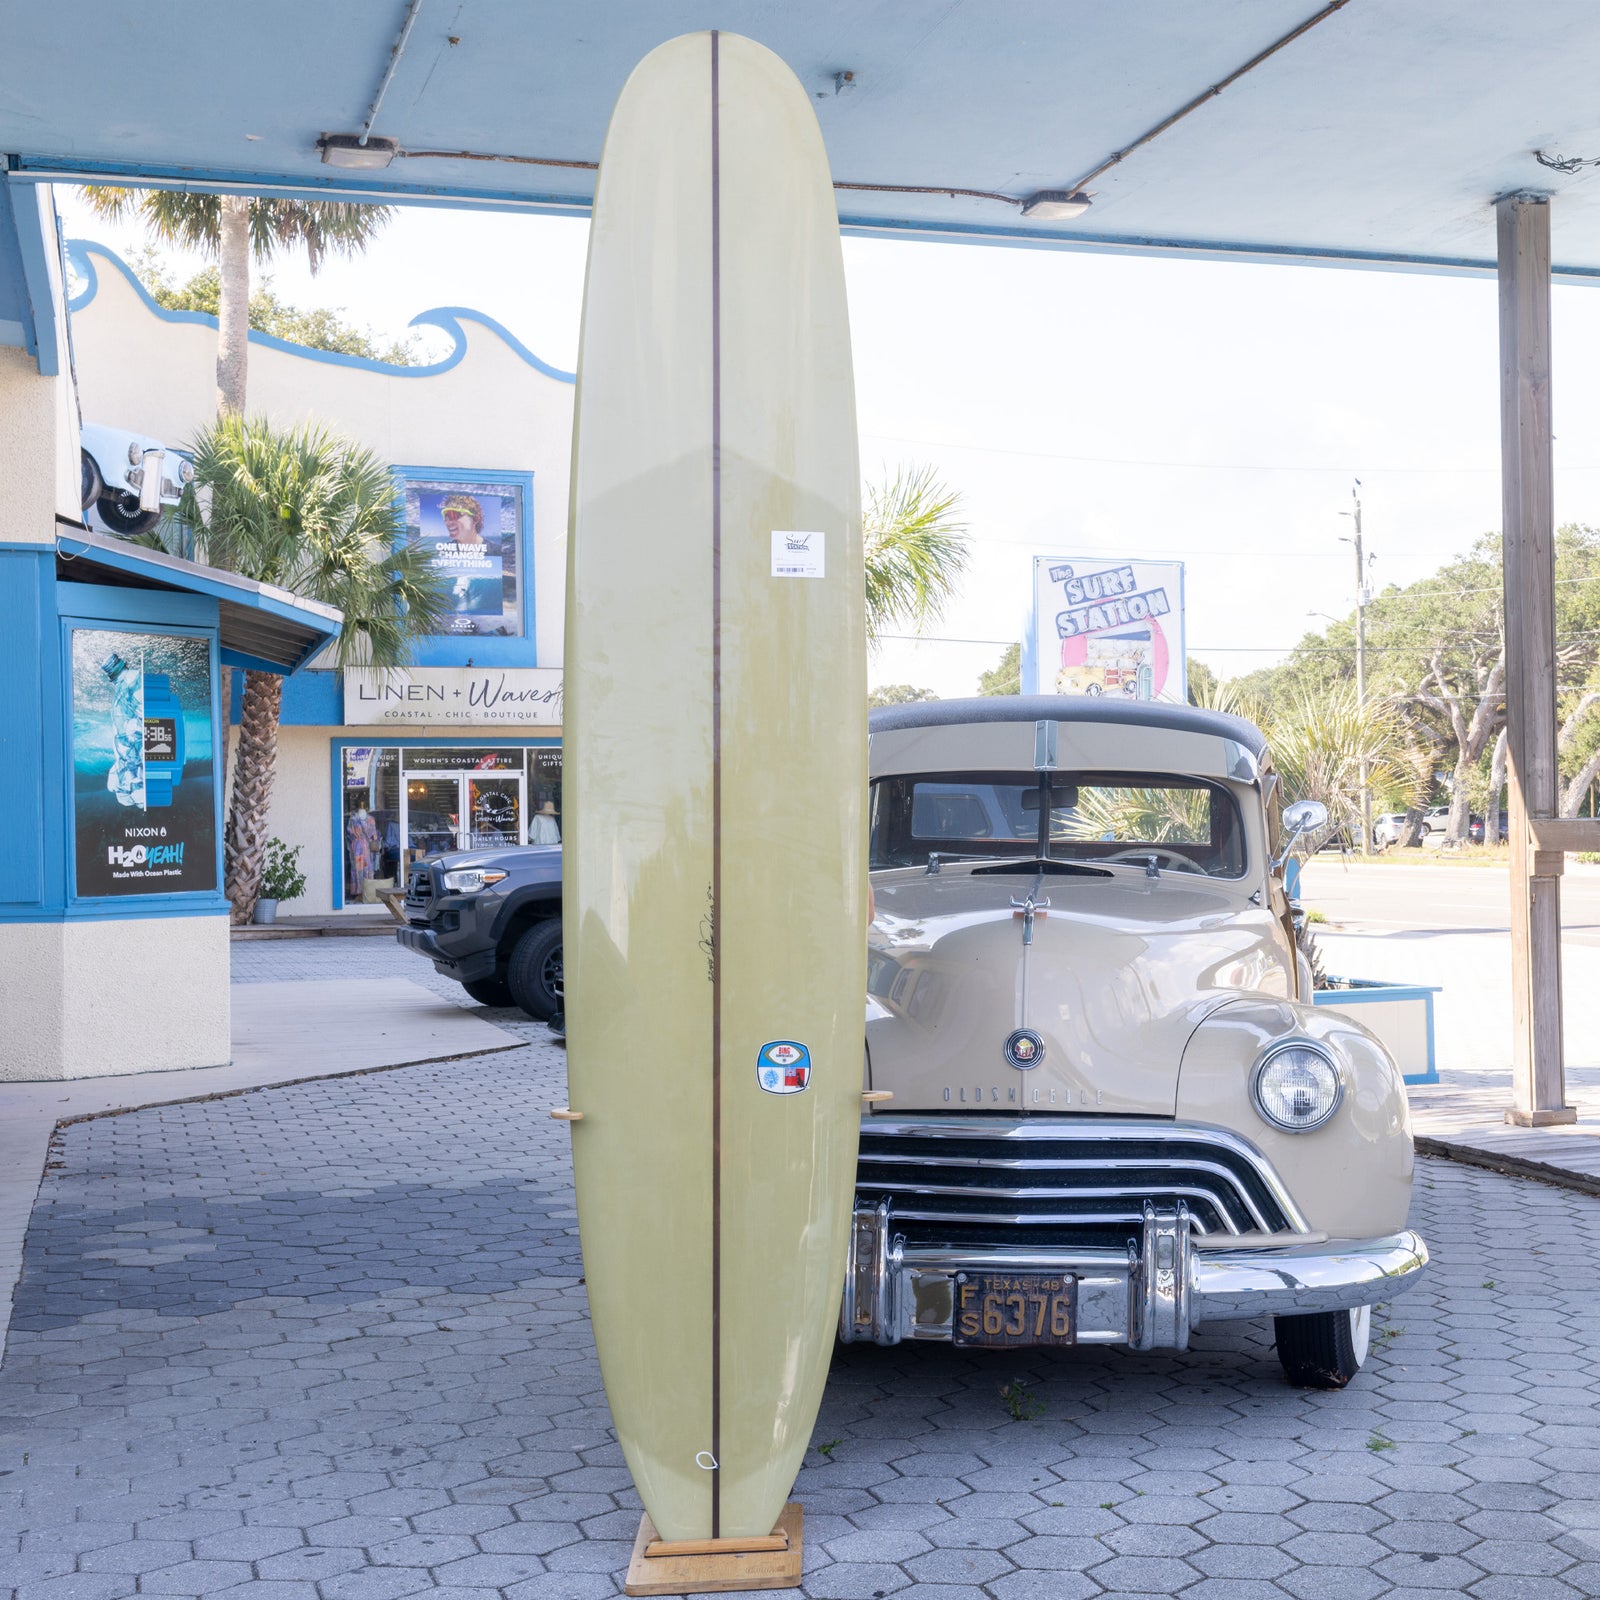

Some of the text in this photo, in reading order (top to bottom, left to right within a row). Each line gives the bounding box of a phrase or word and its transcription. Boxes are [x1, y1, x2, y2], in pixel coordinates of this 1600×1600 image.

[436, 543, 487, 552] ONE WAVE
[438, 551, 485, 560] CHANGES
[431, 560, 492, 568] EVERYTHING
[1050, 568, 1073, 580] The
[1067, 569, 1133, 603] SURF
[1057, 590, 1169, 637] STATION
[359, 684, 444, 701] LINEN
[469, 673, 559, 708] Waves
[384, 710, 539, 720] COASTAL CHIC BOUTIQUE
[125, 827, 158, 837] NIXON
[145, 842, 185, 868] YEAH!
[130, 870, 144, 878] With
[144, 869, 162, 877] Ocean
[163, 868, 182, 877] Plastic
[983, 1280, 1031, 1290] TEXAS
[984, 1295, 1070, 1336] 6376
